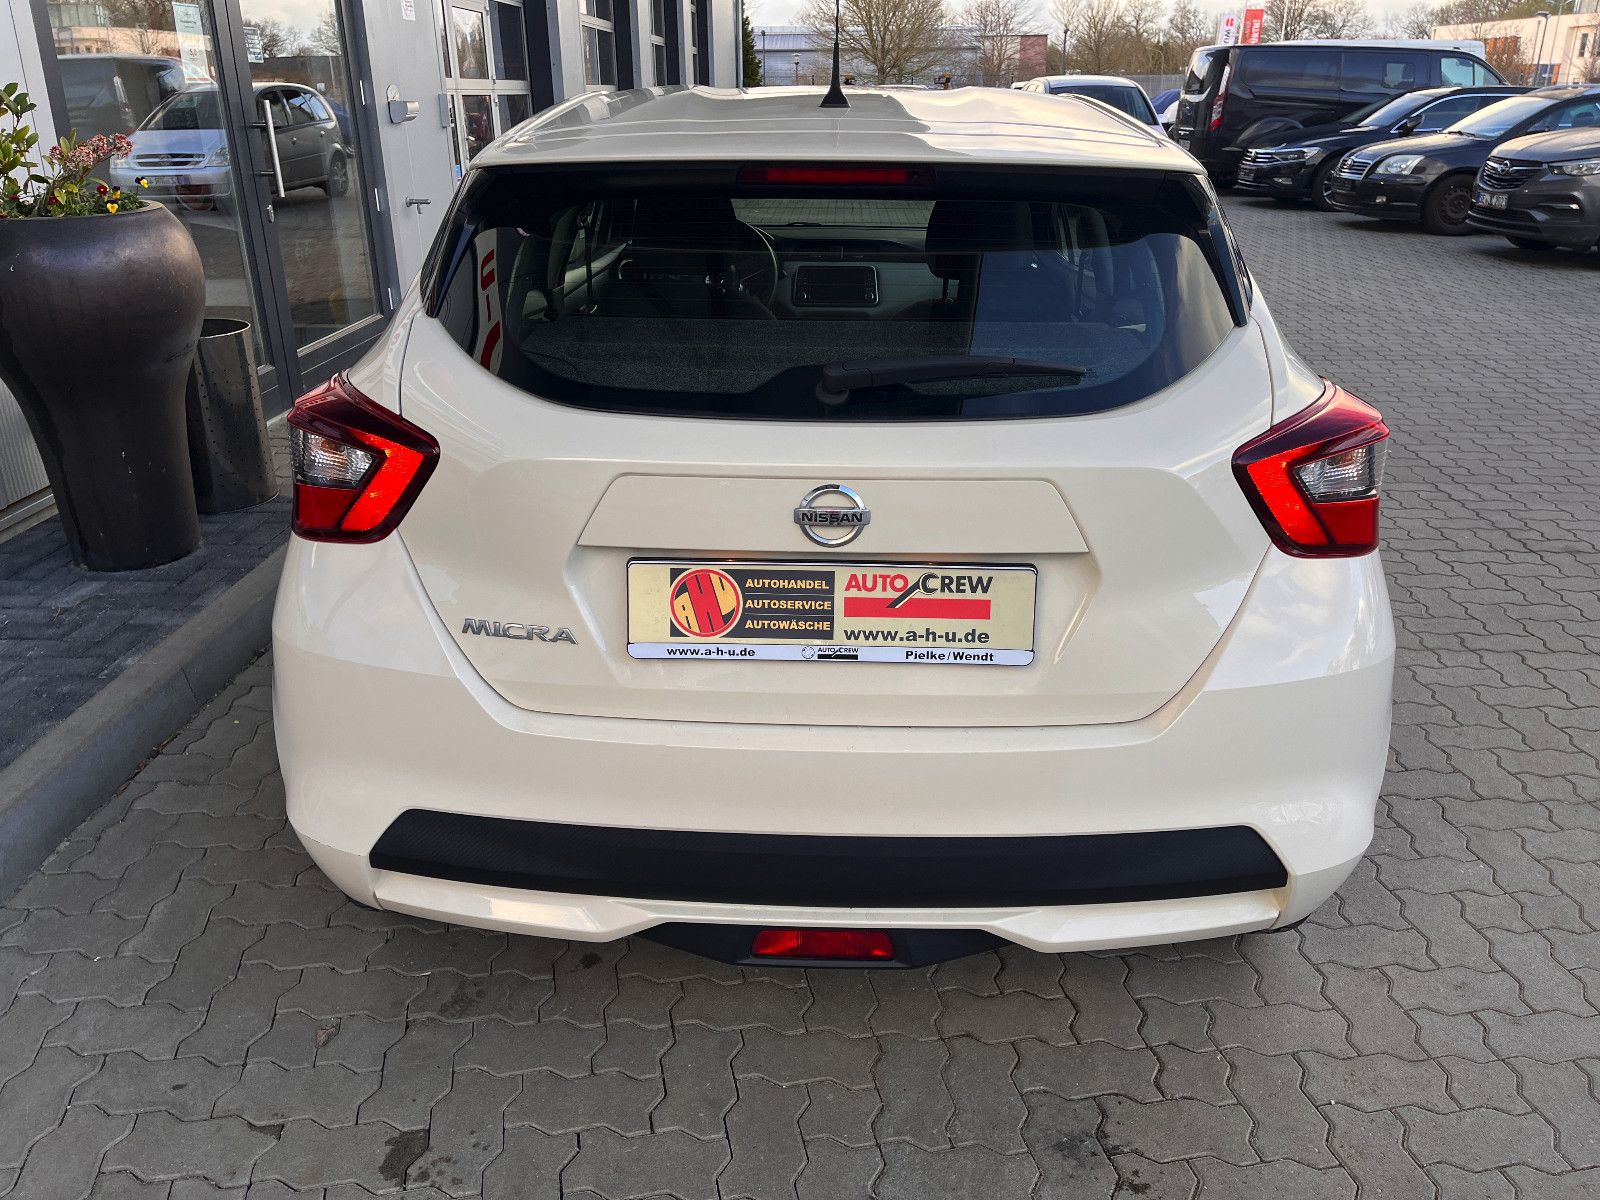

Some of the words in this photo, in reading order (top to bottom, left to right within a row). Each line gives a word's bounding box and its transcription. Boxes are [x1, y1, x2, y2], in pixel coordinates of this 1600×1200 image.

[801, 512, 863, 523] NISSAN
[745, 578, 830, 590] AUTOHANDEL
[844, 573, 909, 593] AUTO
[920, 572, 993, 594] CREW
[745, 599, 832, 611] AUTOSERVICE
[745, 619, 831, 631] AUTOWÄSCHE
[461, 618, 578, 645] MICRA
[844, 628, 990, 643] www.a-h-u.de
[667, 646, 756, 657] www.a-h-u.de
